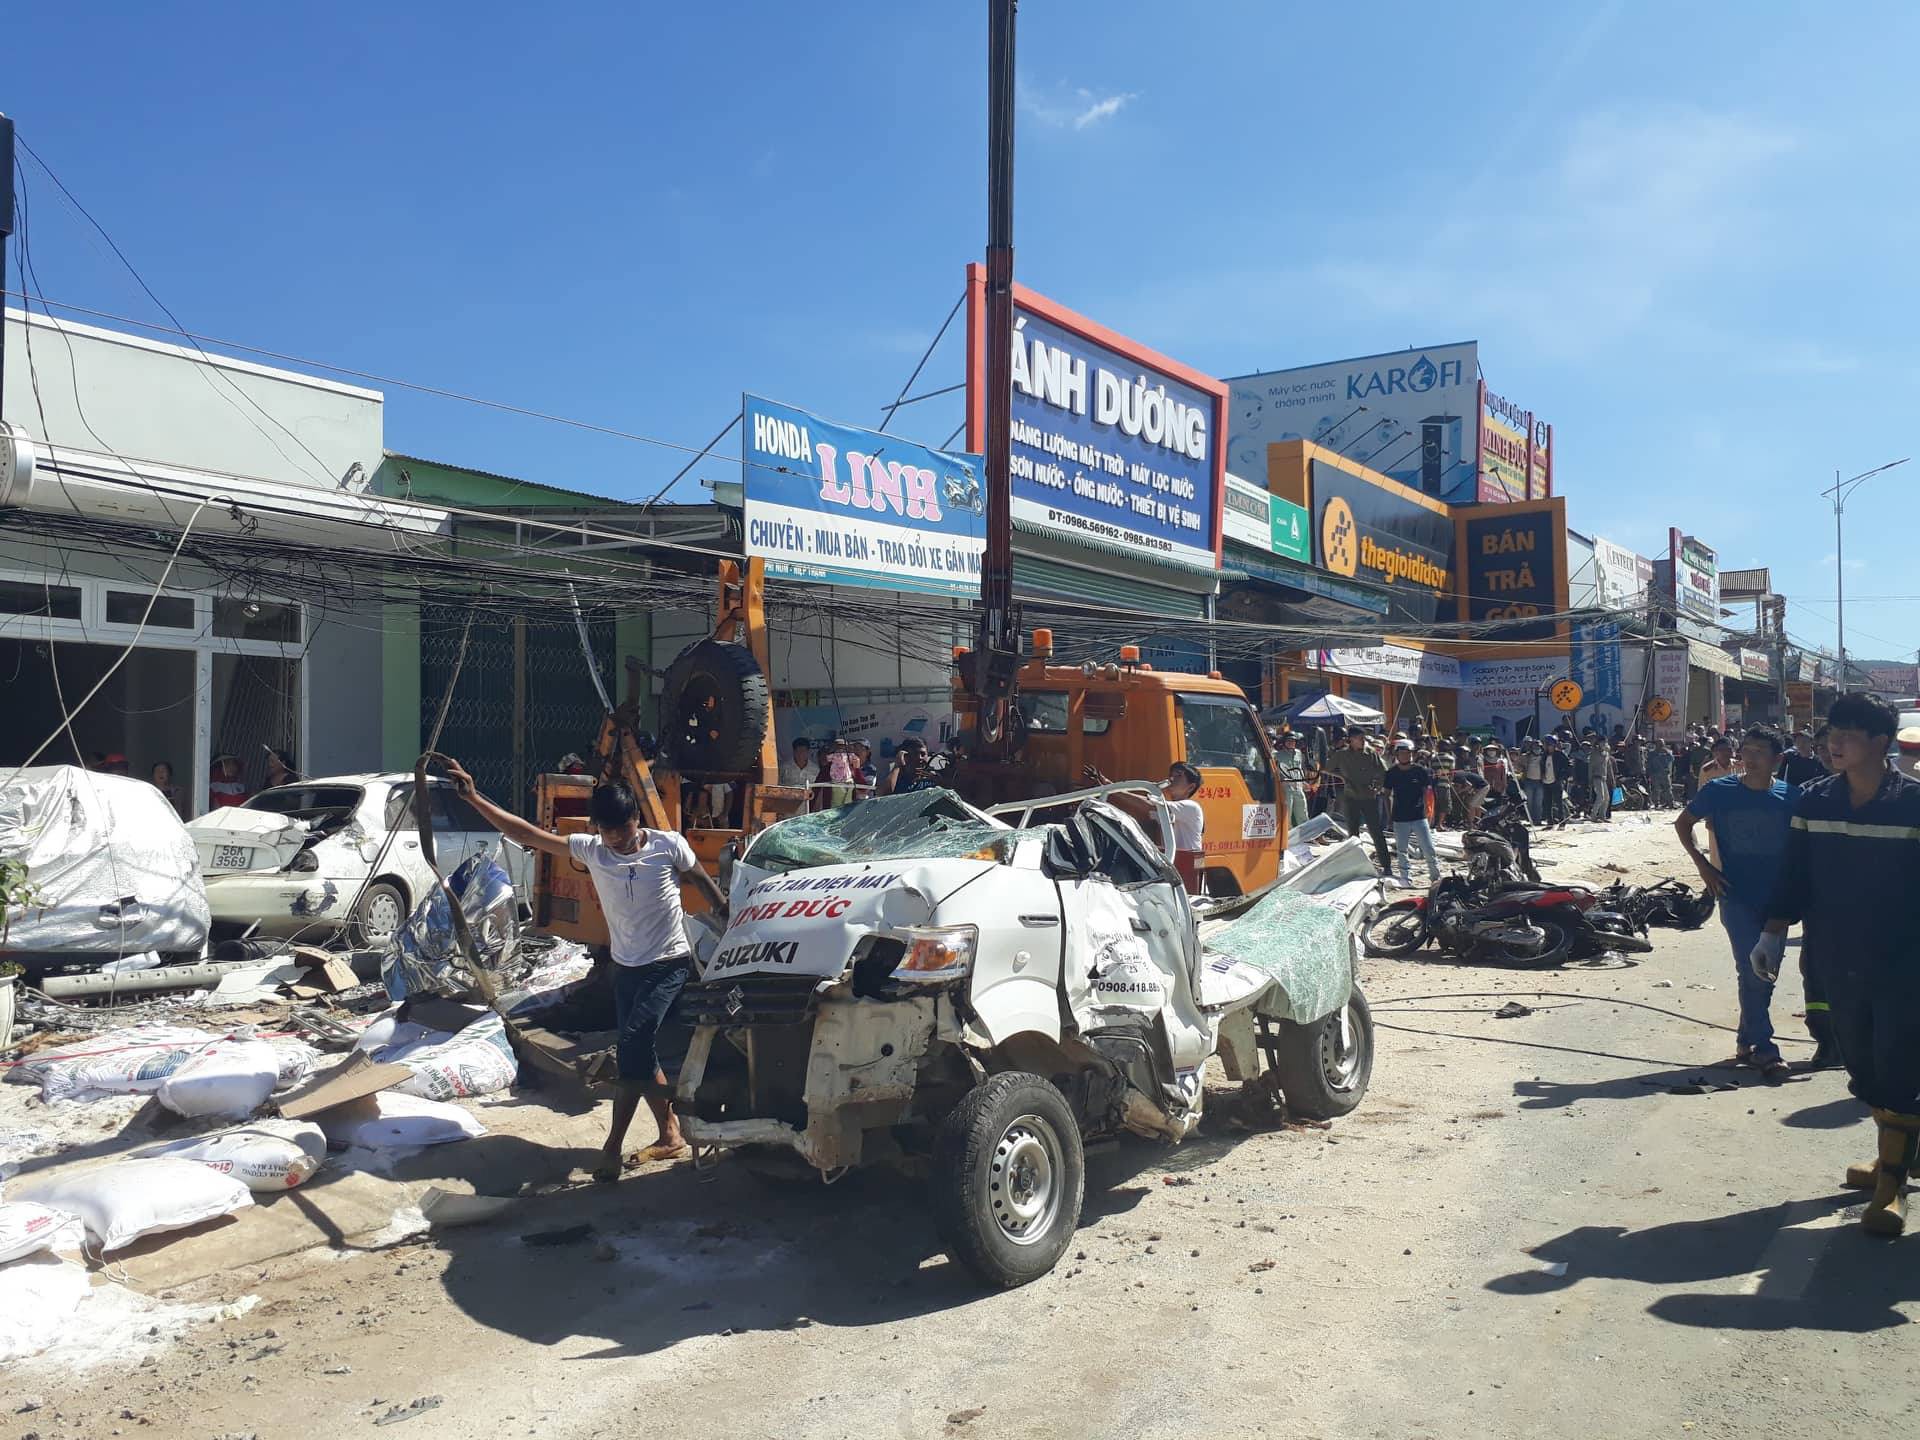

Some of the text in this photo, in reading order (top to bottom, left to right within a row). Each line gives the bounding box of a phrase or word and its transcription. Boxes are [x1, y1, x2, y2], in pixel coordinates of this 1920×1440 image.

[1011, 317, 1205, 460] ÁNH DƯƠNG
[1347, 354, 1463, 400] KAROFI
[754, 413, 812, 463] HONDA
[1043, 432, 1078, 461] LƯỢNG
[1102, 454, 1124, 476] TRỜI
[1131, 462, 1150, 485] MÁY
[1152, 471, 1169, 494] LỌC
[1171, 475, 1194, 500] NƯỚC
[816, 443, 943, 522] LINH
[1010, 454, 1033, 479] SƠN
[1035, 463, 1065, 489] NƯỚC
[1074, 470, 1095, 498] ỐNG
[1097, 482, 1124, 507] NƯỚC
[1181, 510, 1200, 531] SINH
[750, 517, 804, 553] CHUYÊN
[815, 528, 841, 557] MUA
[845, 529, 869, 561] BÁN
[877, 539, 906, 567] TRAO
[929, 547, 943, 570] XE
[967, 547, 981, 575] MÁ
[1482, 529, 1536, 555] BÁN
[1484, 562, 1536, 591] TRẢ
[1199, 787, 1232, 799] 24/24
[215, 856, 246, 868] 3569
[222, 845, 243, 857] 56K
[811, 874, 854, 894] ĐIỆN
[855, 872, 900, 890] MÁY
[781, 896, 852, 919] ĐỨC
[714, 941, 799, 971] SUZUKI
